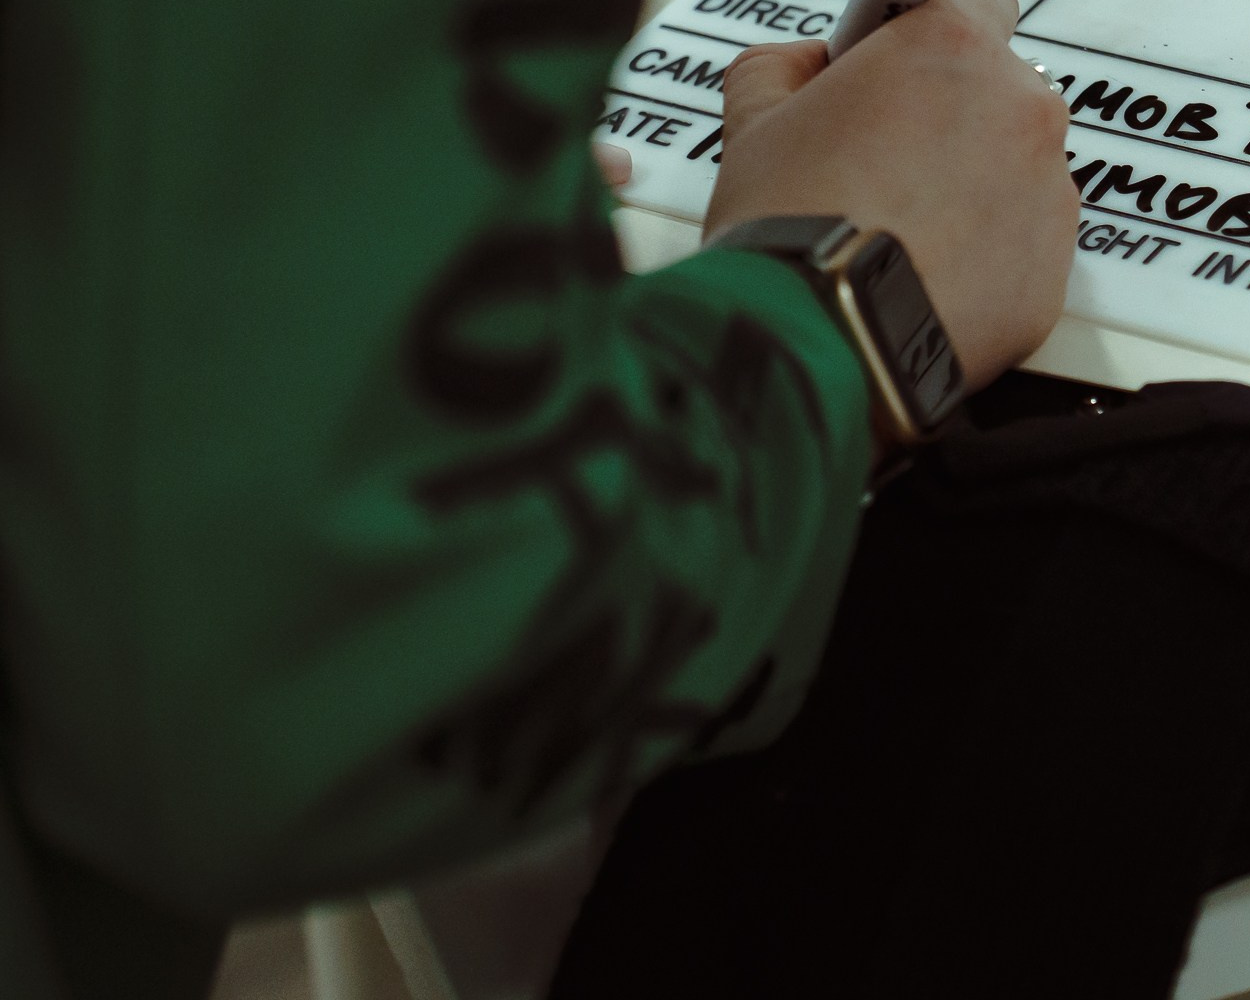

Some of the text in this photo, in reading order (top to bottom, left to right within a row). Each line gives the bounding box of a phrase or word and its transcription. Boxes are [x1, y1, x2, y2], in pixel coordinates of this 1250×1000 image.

[629, 48, 724, 93] CAM
[601, 106, 692, 147] ATE
[1054, 74, 1219, 141] МОВ
